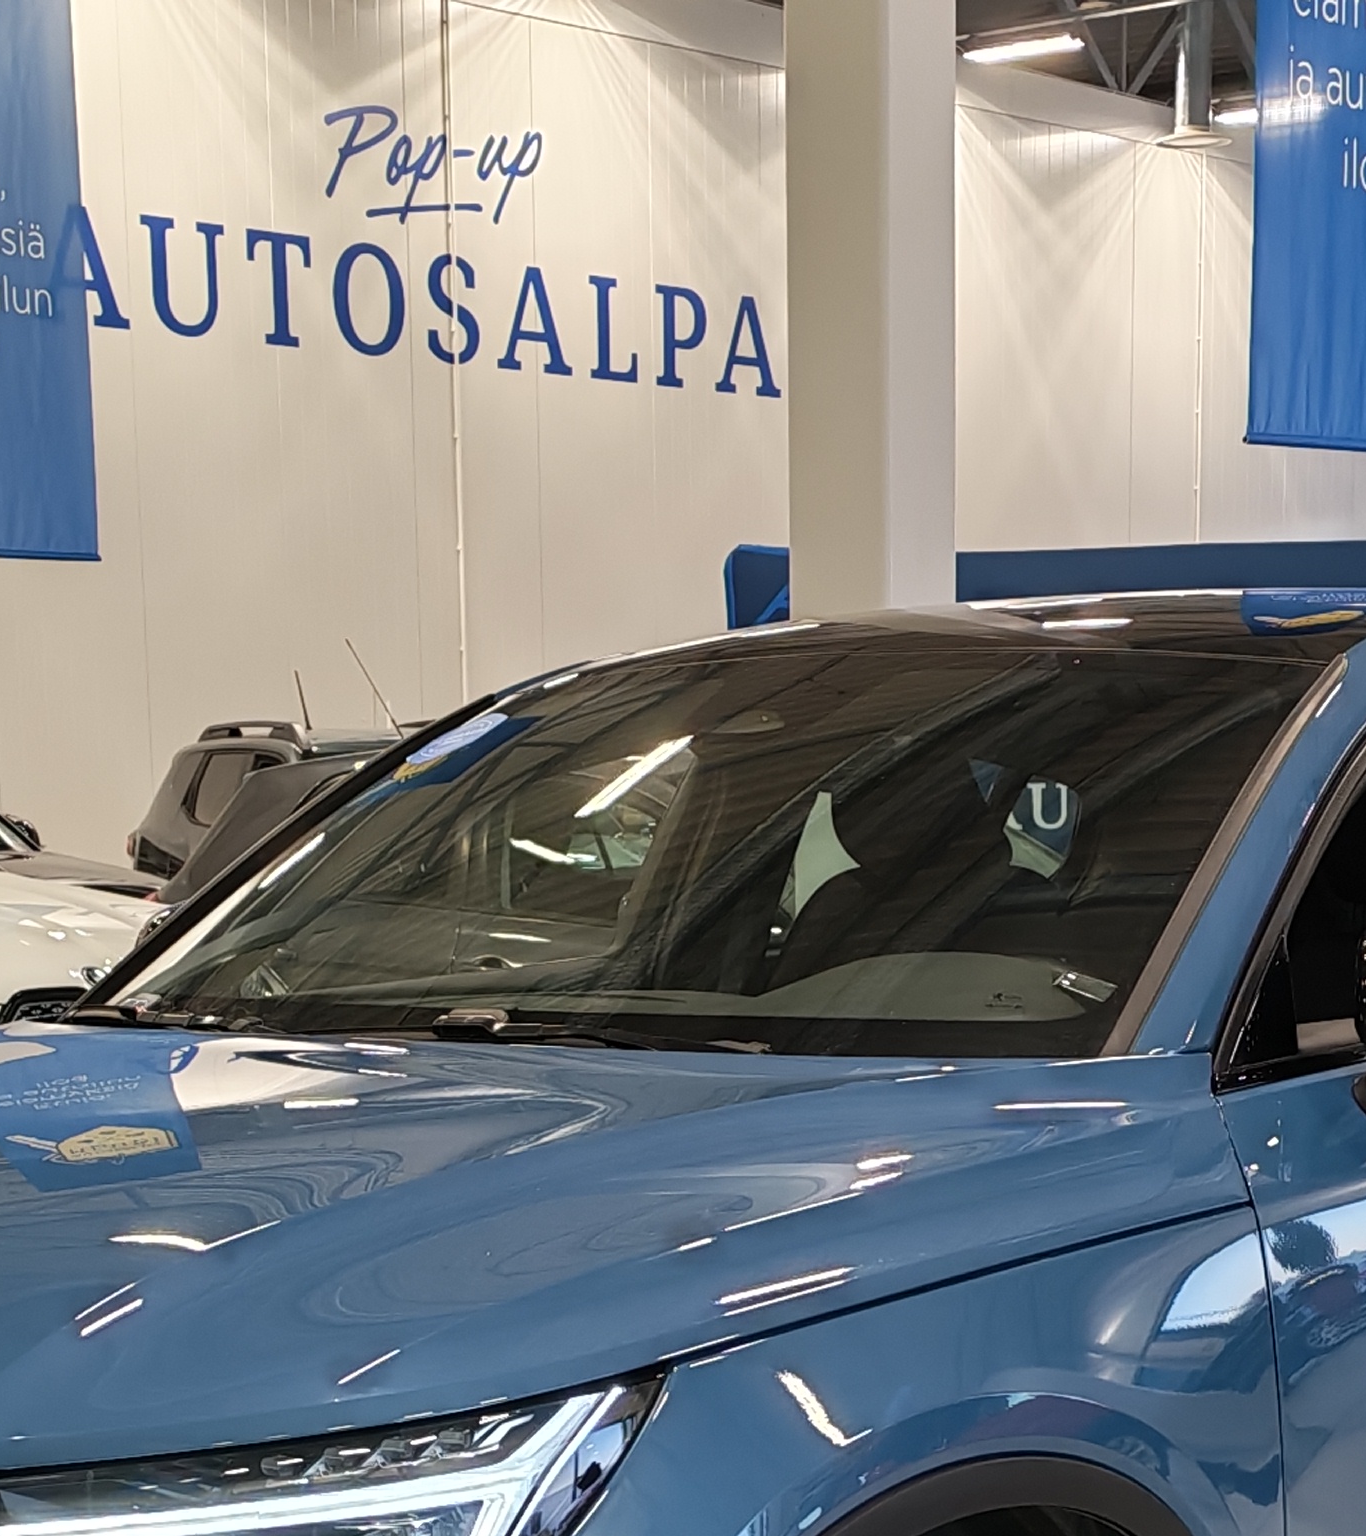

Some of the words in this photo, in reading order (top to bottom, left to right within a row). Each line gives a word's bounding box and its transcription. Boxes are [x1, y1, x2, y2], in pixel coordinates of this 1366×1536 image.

[1288, 45, 1314, 107] ja
[323, 105, 543, 224] Pop-up
[47, 204, 782, 399] AUTOSALPA
